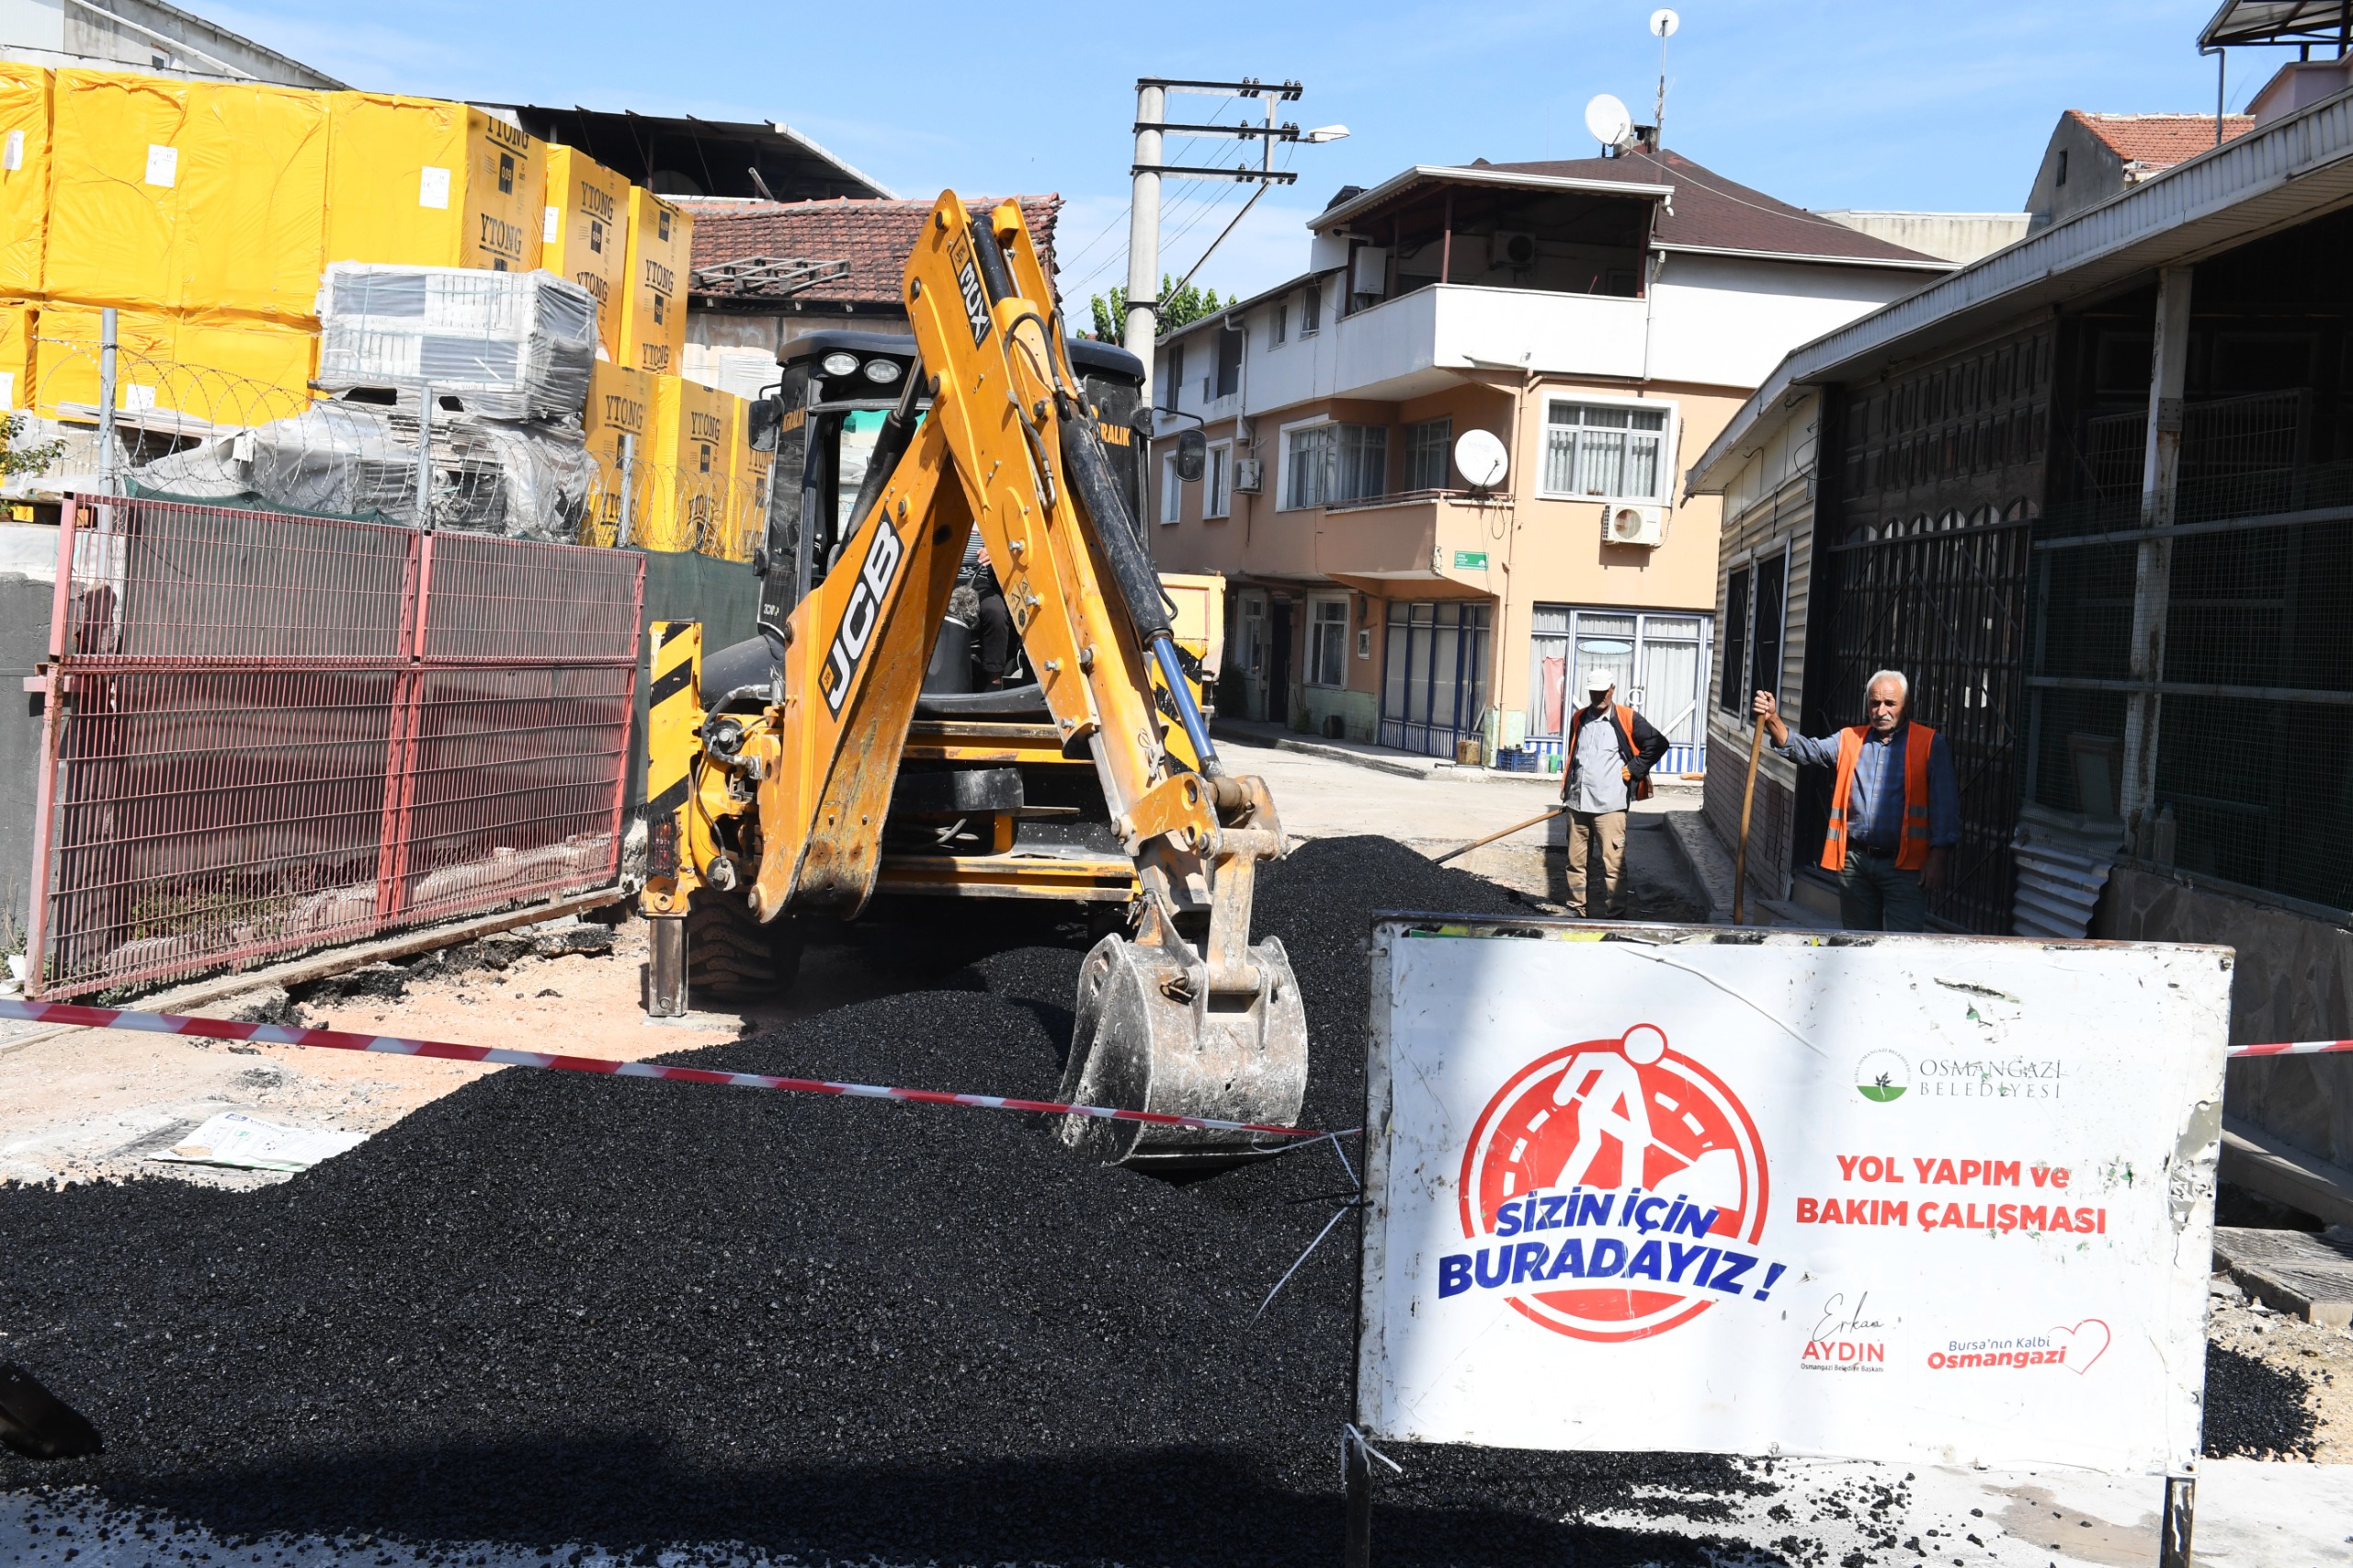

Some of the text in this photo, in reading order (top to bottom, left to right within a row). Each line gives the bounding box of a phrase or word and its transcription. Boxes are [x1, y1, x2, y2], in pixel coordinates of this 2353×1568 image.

[581, 180, 614, 221] YTONG
[481, 212, 522, 256] YTONG
[645, 259, 674, 293] YTONG
[606, 395, 643, 430] YTONG
[691, 411, 721, 441] YTONG
[1094, 421, 1131, 448] RALIK
[829, 521, 899, 710] JCB
[1920, 1059, 2061, 1079] OSMANGAZİ
[1920, 1082, 2061, 1098] BELEDİYESİ
[1836, 1155, 2070, 1188] YOL YAPIM ve
[1495, 1186, 1720, 1240] SİZİN İÇİN
[1796, 1198, 2106, 1234] BAKIM ÇALIŞMASI
[1813, 1290, 1884, 1342] Erkan
[1802, 1341, 1884, 1362] AYDIN
[1927, 1346, 2067, 1369] Osmangazi
[1949, 1336, 2051, 1351] Bursa'nın Kalbi
[1801, 1363, 1833, 1371] Osmangazi
